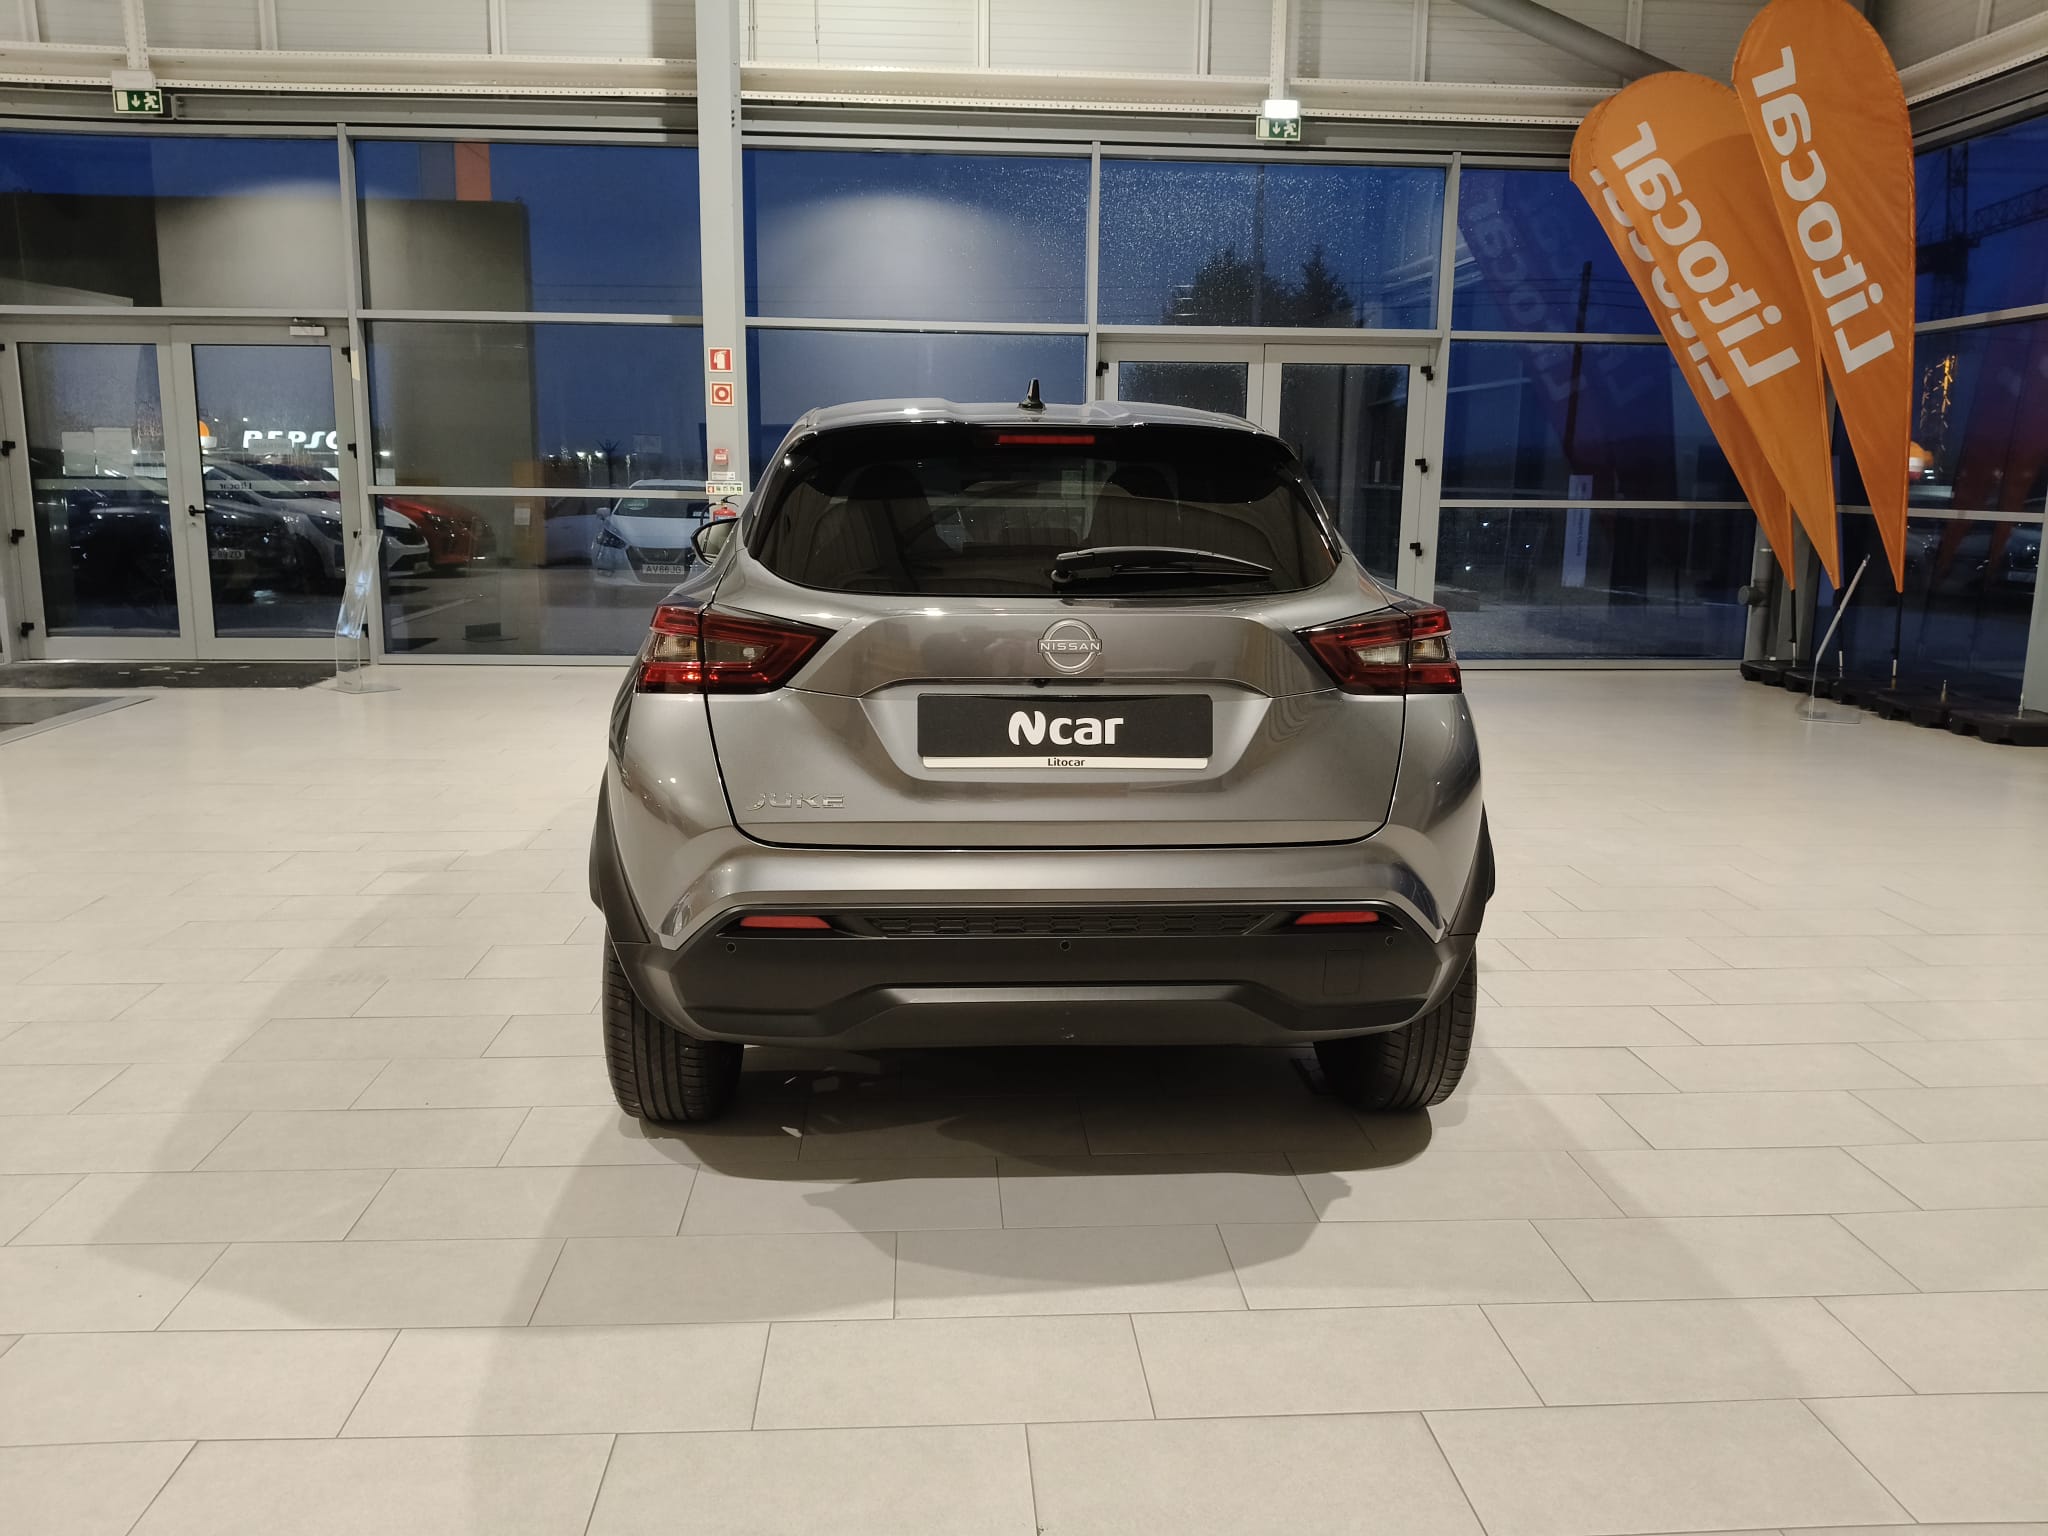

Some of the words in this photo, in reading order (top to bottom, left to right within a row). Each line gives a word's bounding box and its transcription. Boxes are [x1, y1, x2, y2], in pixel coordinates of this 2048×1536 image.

[1040, 642, 1100, 651] NISSAN
[1008, 710, 1124, 746] Ncar
[1047, 757, 1086, 767] Litocar
[745, 792, 846, 811] JUKE
